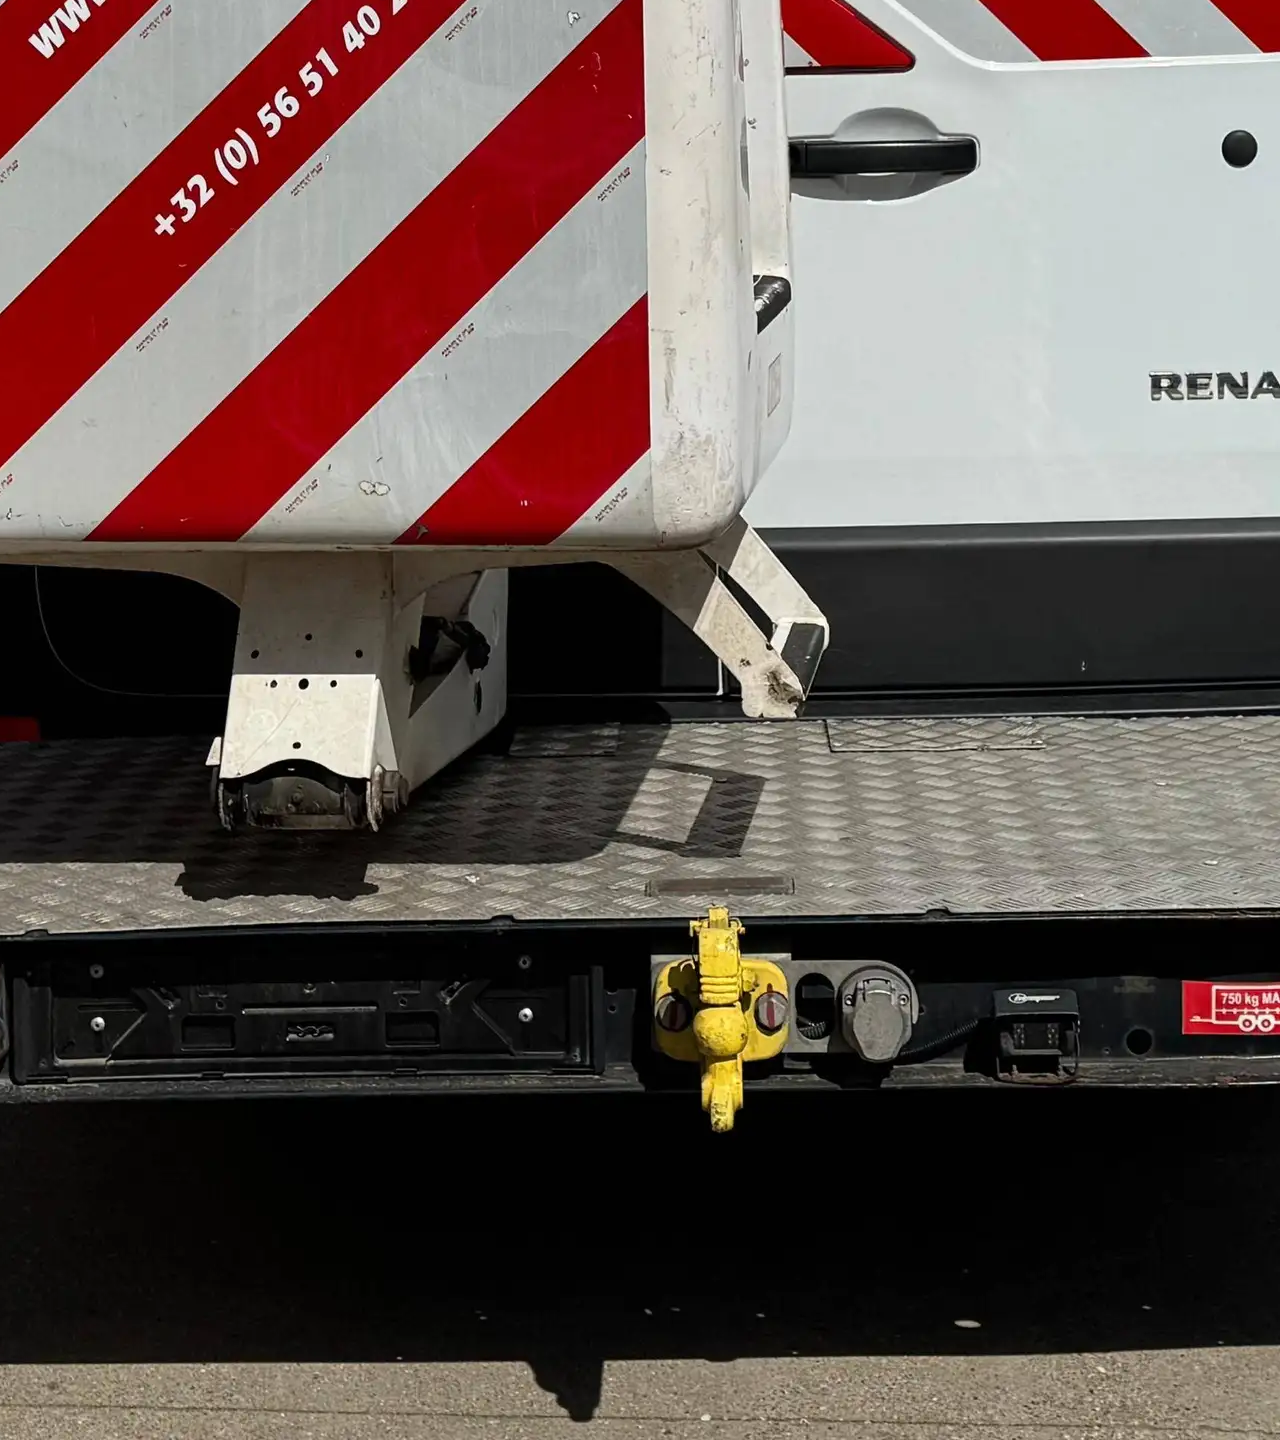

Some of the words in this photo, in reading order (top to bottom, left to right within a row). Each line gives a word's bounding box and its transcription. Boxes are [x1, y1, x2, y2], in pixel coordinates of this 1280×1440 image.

[154, 174, 215, 237] +32
[214, 127, 260, 186] (0)
[256, 85, 300, 138] 56
[298, 47, 340, 97] 51
[342, 5, 381, 53] 40
[1220, 992, 1242, 1005] 750
[1244, 992, 1260, 1007] kg
